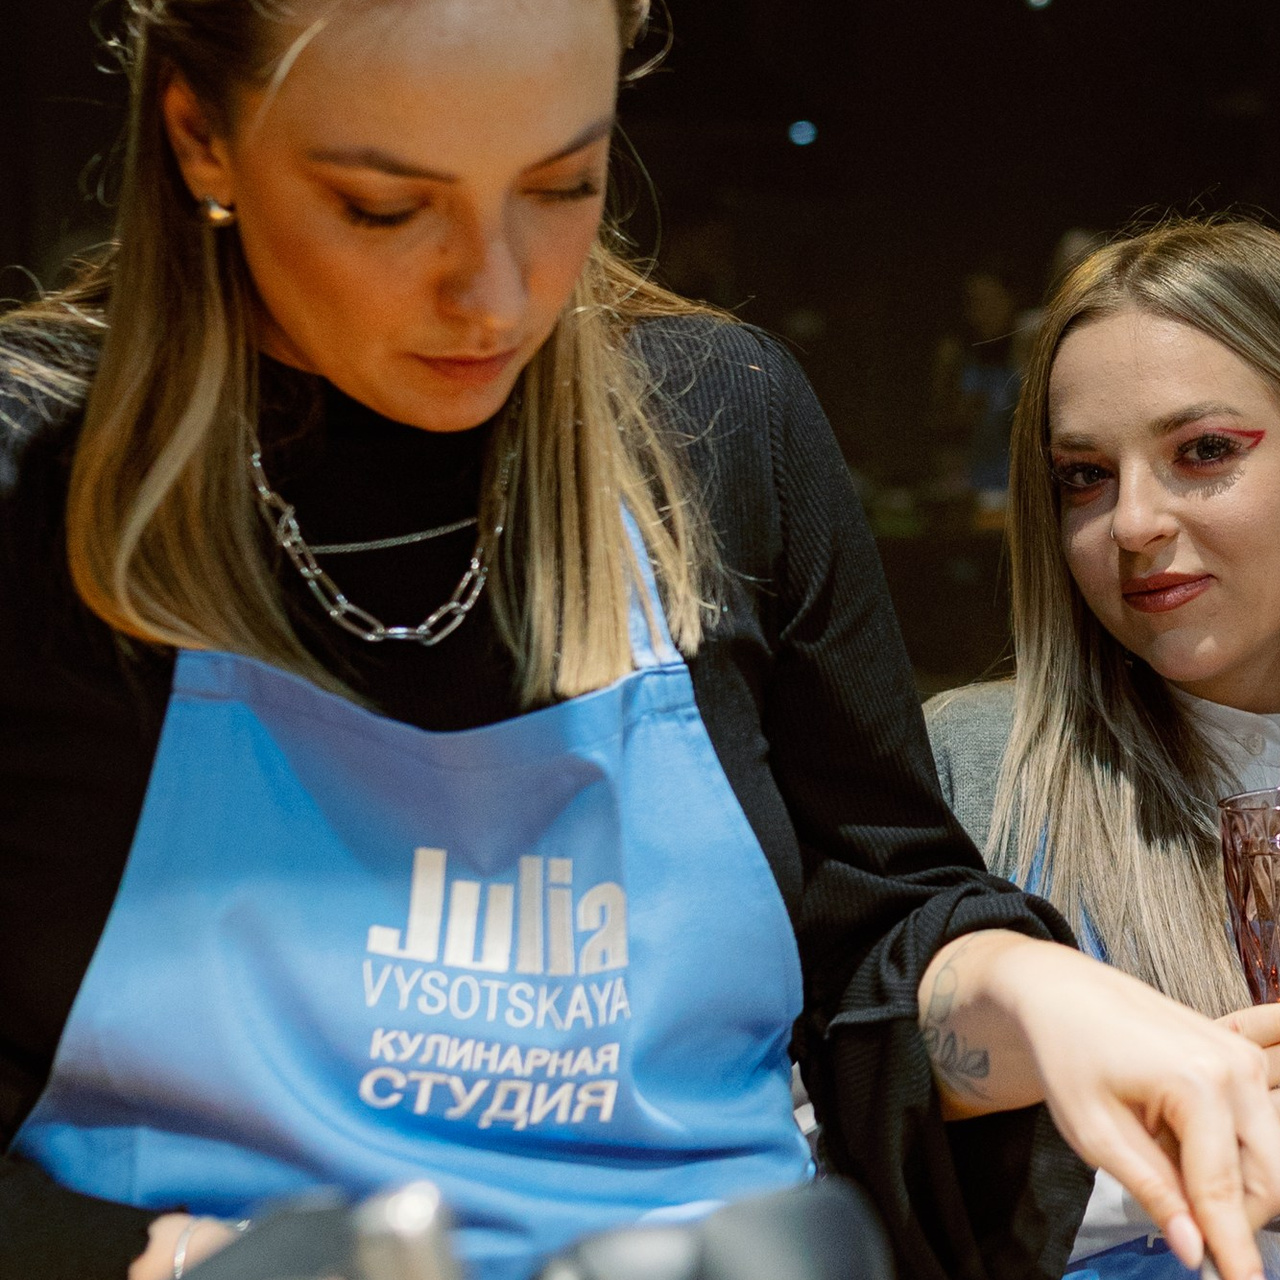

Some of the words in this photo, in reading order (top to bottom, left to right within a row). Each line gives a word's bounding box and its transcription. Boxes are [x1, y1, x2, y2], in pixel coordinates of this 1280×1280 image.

[366, 846, 629, 977] Julia
[362, 959, 631, 1032] VYSOTSKAYA
[369, 1027, 620, 1078] КУЛИНАРНАЯ
[358, 1066, 619, 1131] СТУДИЯ
